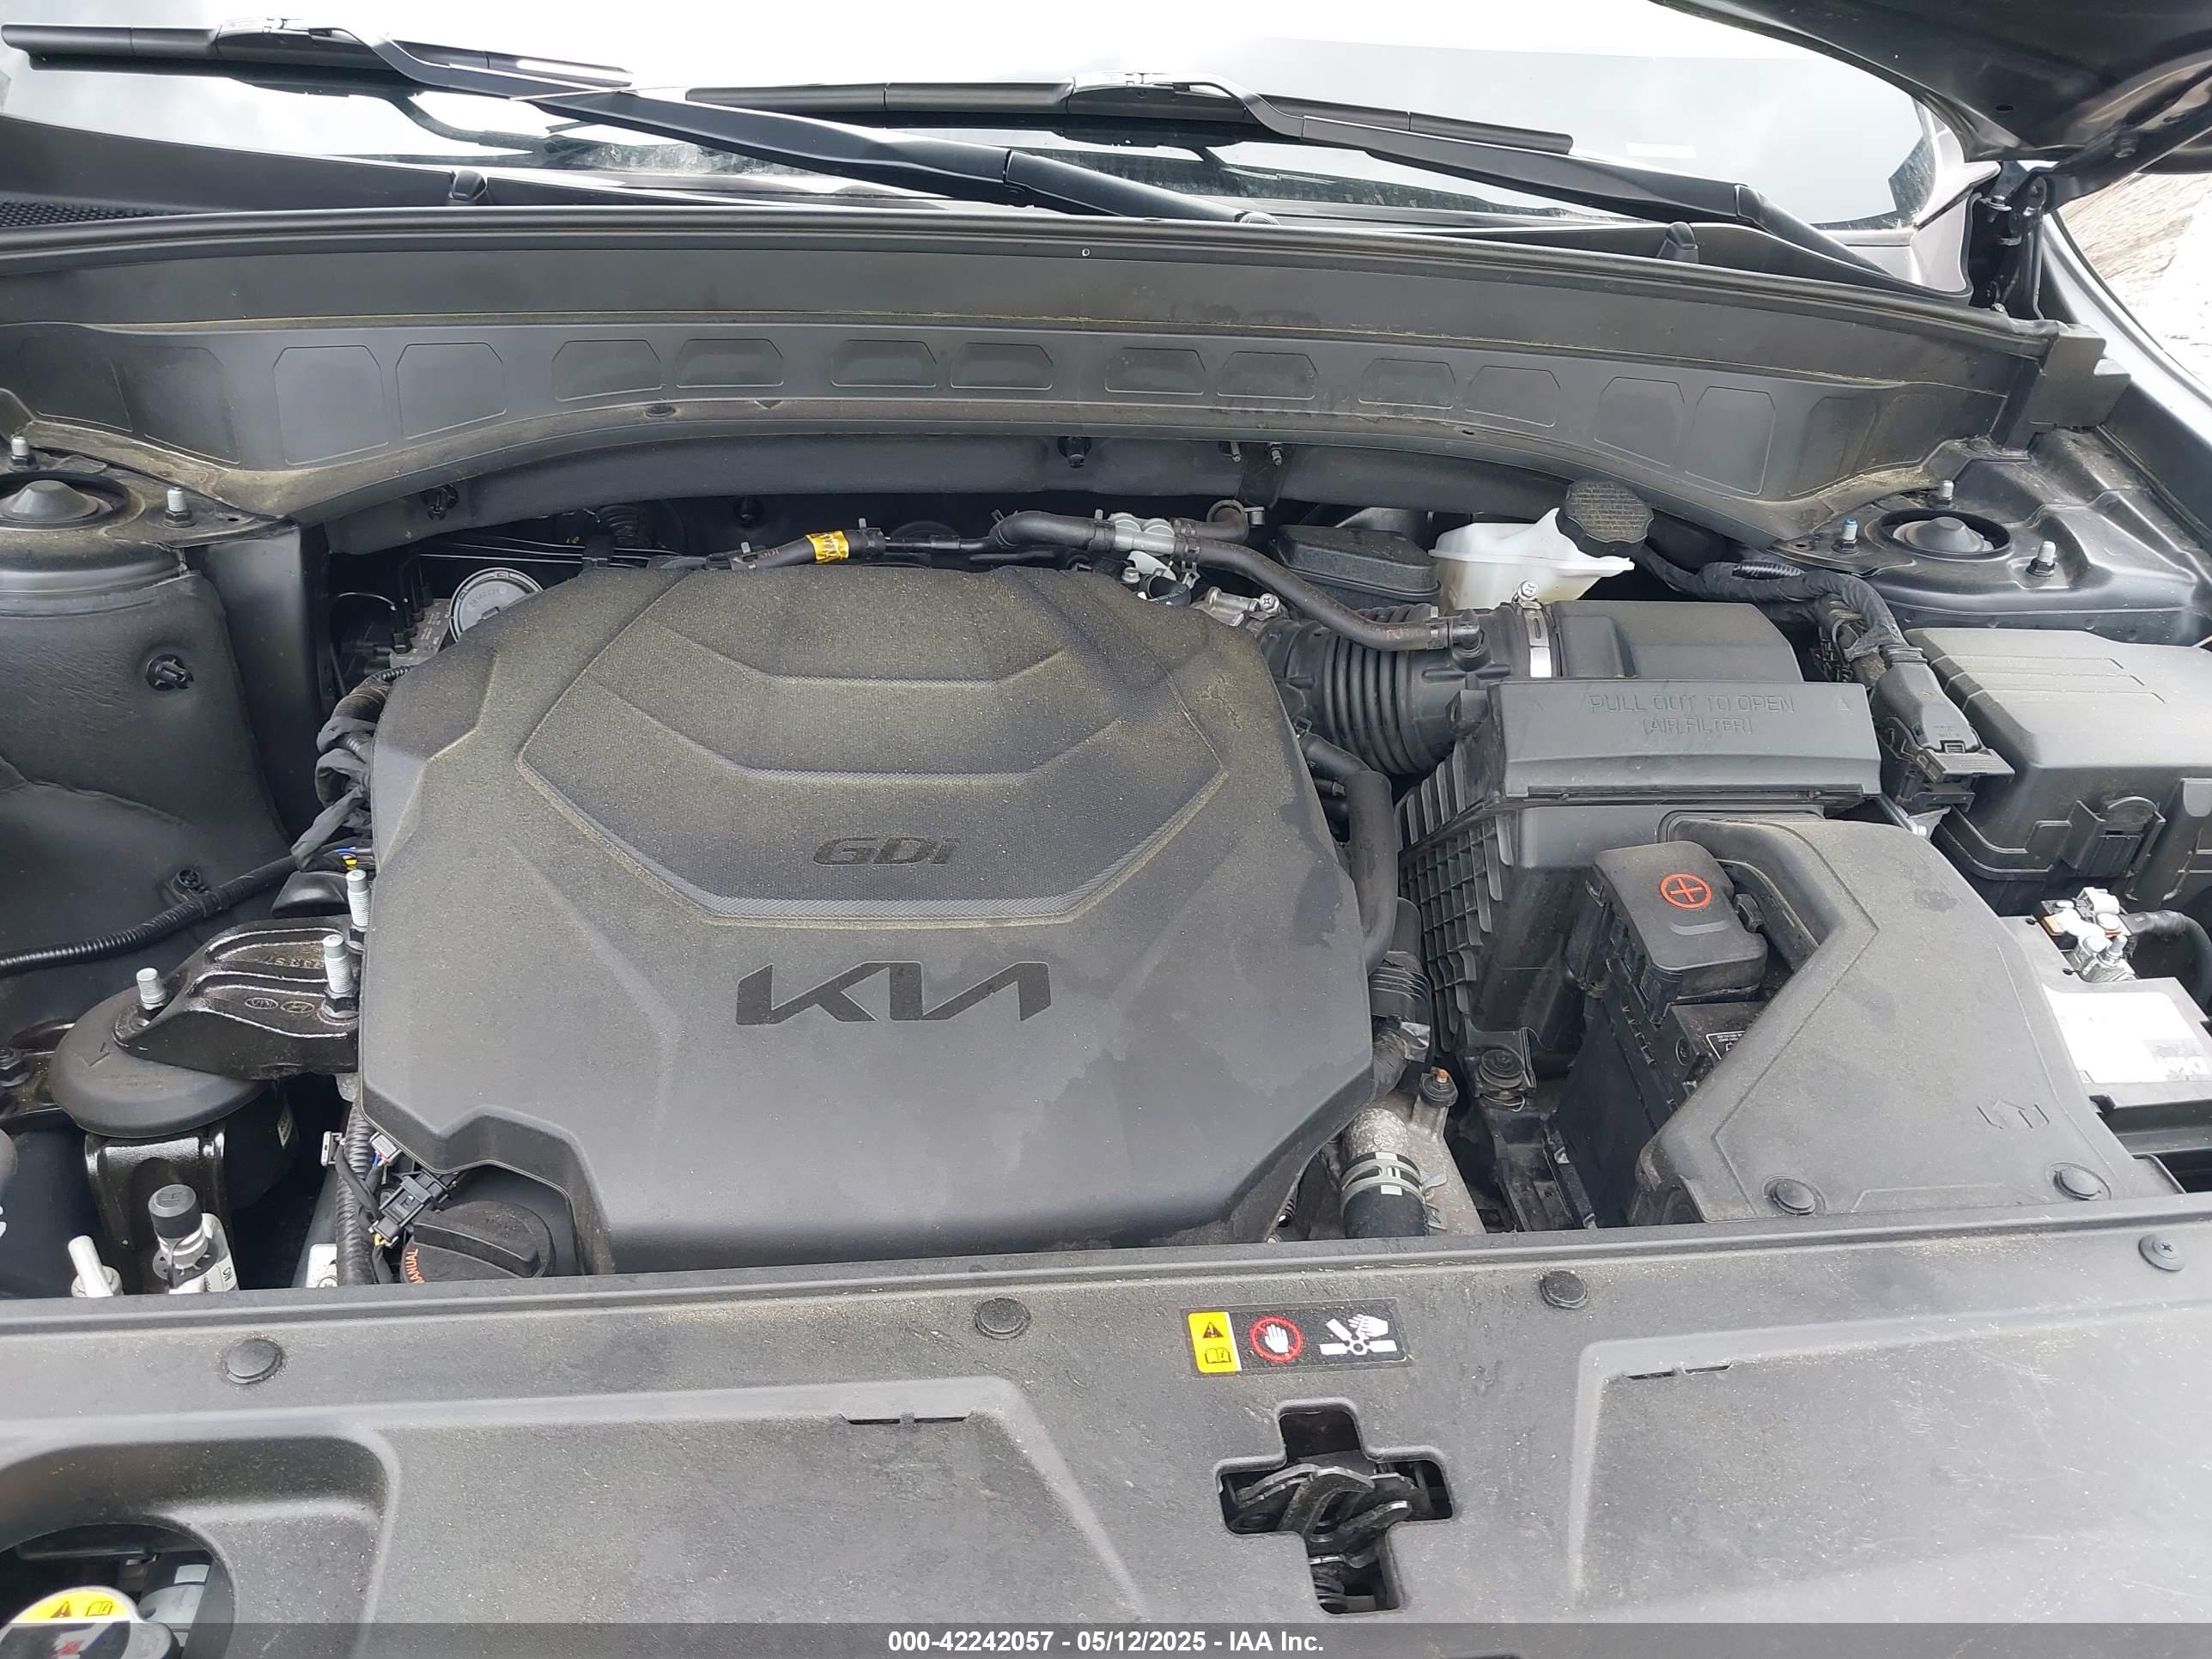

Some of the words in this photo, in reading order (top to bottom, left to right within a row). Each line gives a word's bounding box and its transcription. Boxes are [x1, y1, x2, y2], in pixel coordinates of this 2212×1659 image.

[1589, 694, 1647, 713] PULL
[1652, 694, 1697, 713] OUT
[1705, 694, 1732, 713] TO
[1737, 694, 1796, 714] OPEN
[736, 960, 1052, 1026] KIA
